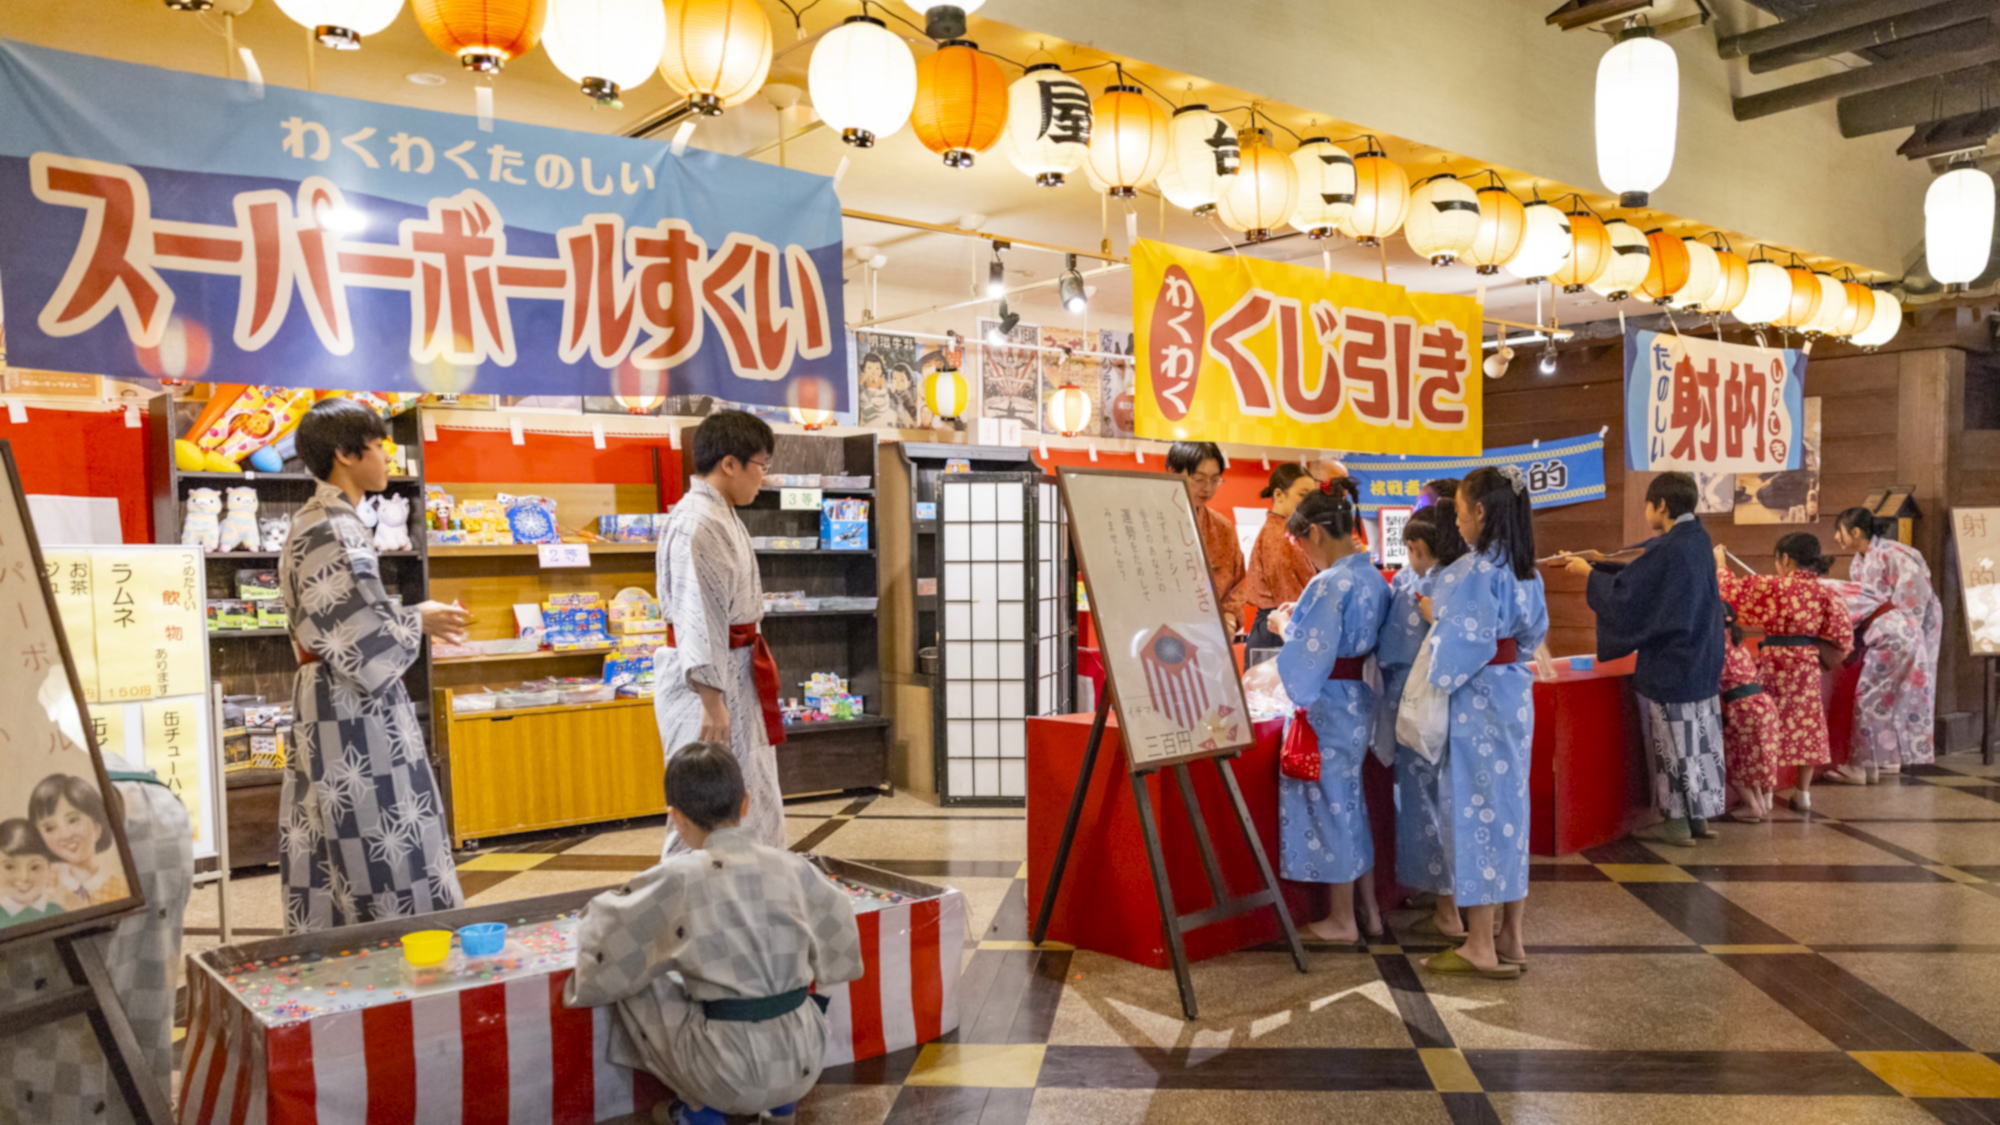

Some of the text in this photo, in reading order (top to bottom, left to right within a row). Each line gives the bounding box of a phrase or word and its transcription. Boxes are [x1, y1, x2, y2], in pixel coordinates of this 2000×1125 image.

[1036, 79, 1093, 147] 屋
[280, 114, 656, 197] わくわくたのしい
[28, 149, 833, 382] スーパーボールすくい
[1160, 274, 1195, 414] わくわく
[1206, 287, 1471, 431] くじ引き
[1651, 344, 1673, 463] たのしい
[1670, 352, 1767, 463] 射的
[1528, 460, 1567, 493] 的
[69, 562, 89, 596] お茶
[111, 562, 136, 629] ラムネ
[161, 589, 184, 642] 飲物
[155, 648, 169, 697] あります
